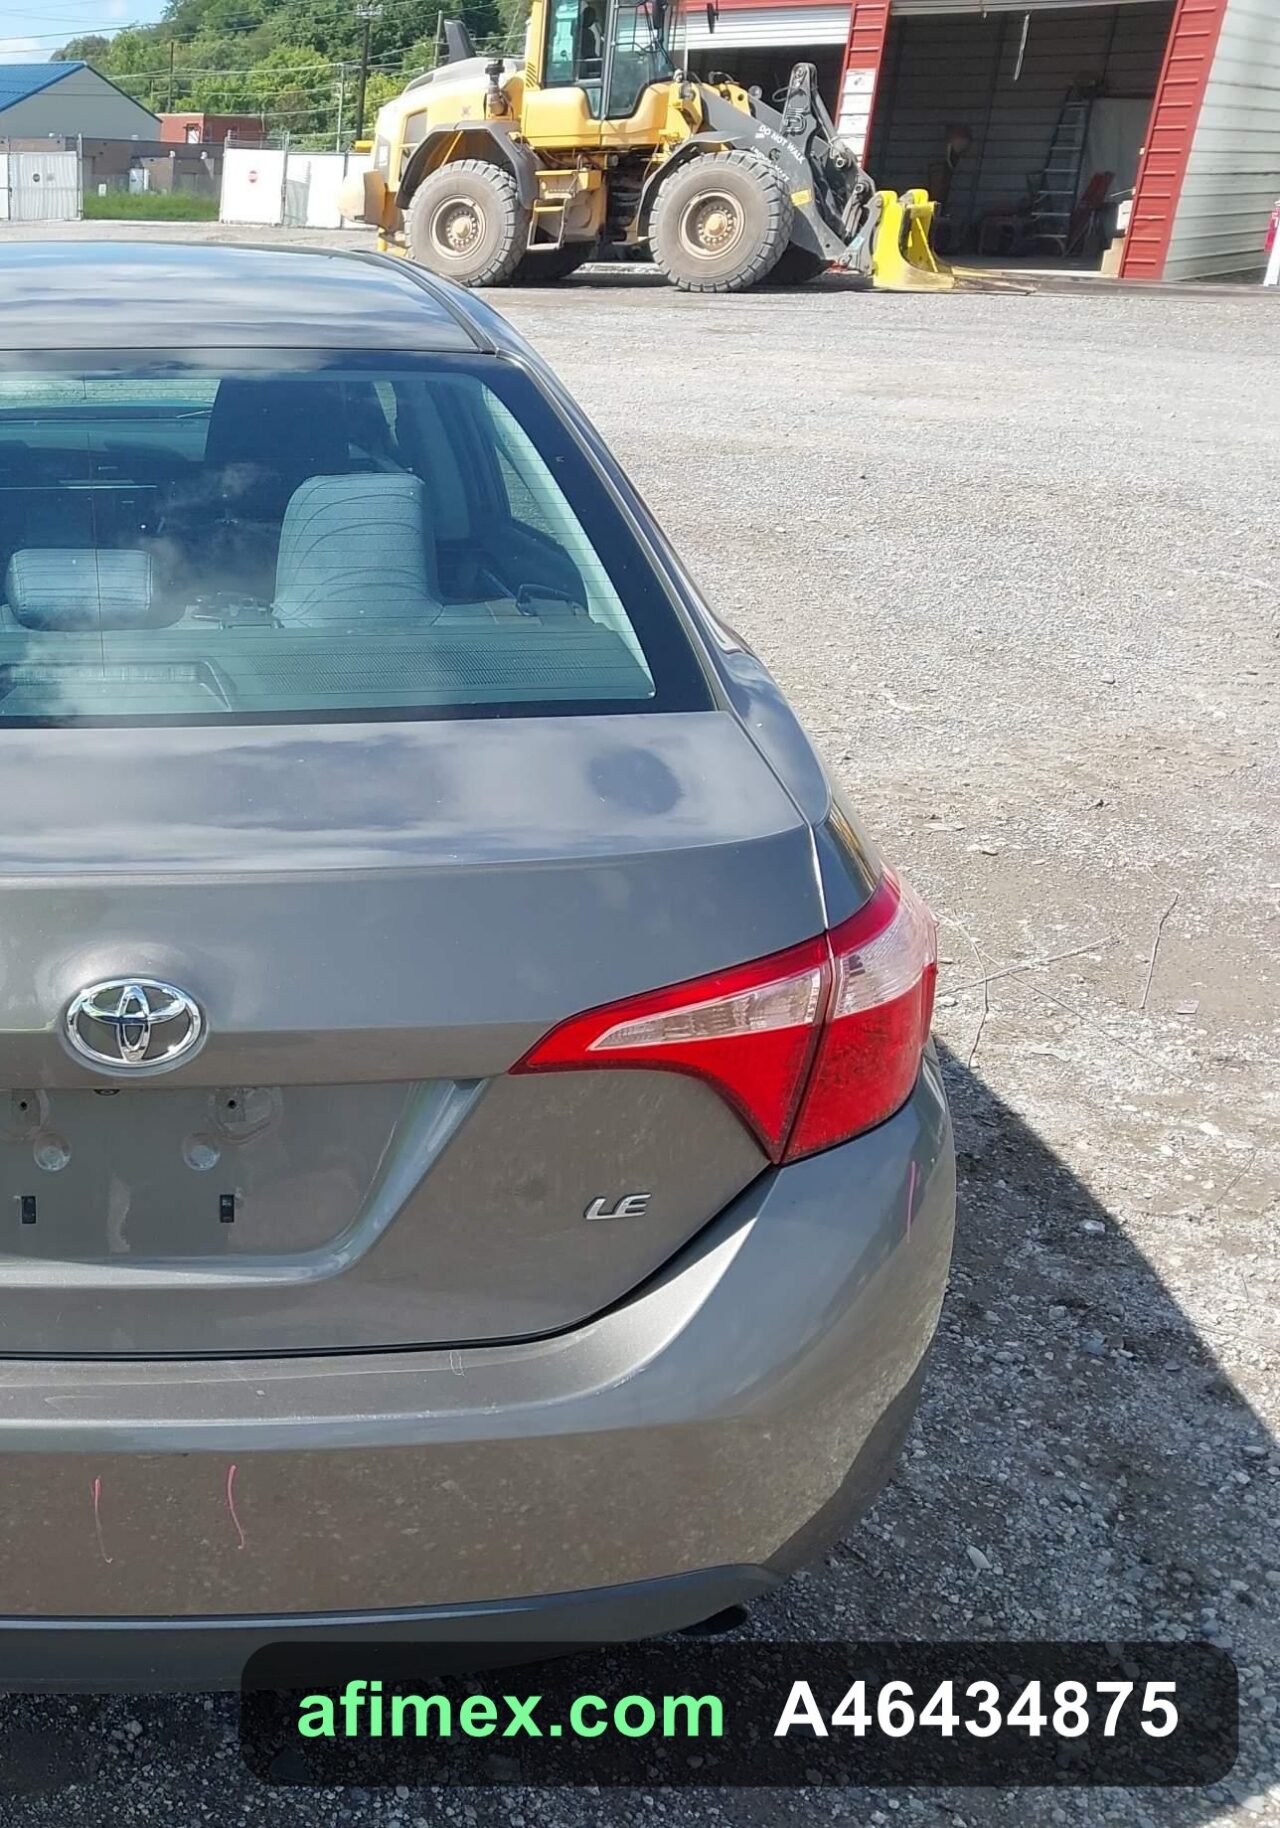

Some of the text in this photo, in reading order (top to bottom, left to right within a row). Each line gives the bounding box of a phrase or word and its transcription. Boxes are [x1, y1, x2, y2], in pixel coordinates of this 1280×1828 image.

[759, 124, 806, 165] DO NOT WALK
[583, 1193, 652, 1220] LE
